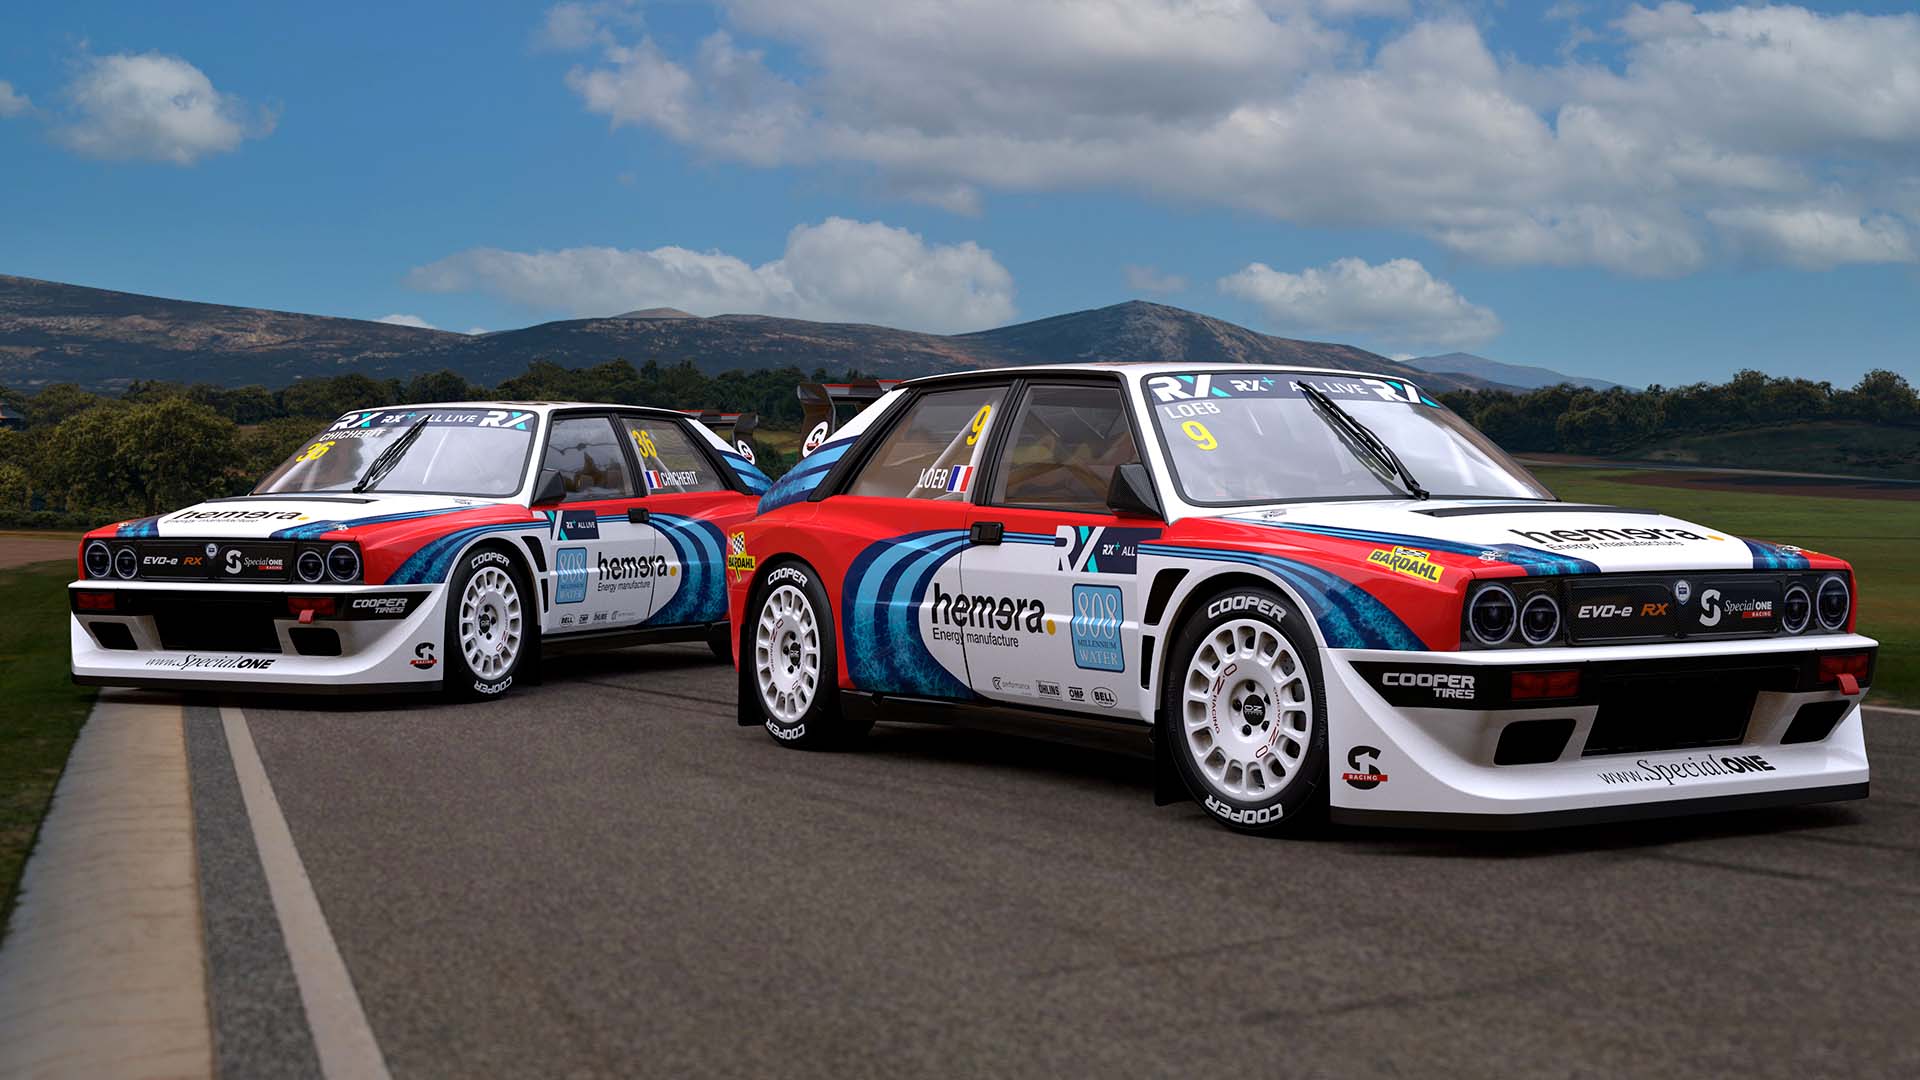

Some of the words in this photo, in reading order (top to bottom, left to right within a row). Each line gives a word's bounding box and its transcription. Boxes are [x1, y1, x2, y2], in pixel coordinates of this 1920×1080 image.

[1289, 381, 1327, 393] AL
[1323, 382, 1368, 395] LIVE
[444, 414, 476, 424] LIVE
[1165, 402, 1221, 420] LOEB
[967, 404, 992, 446] 9
[319, 428, 384, 442] CHICHERIT
[1181, 420, 1219, 451] 9
[296, 440, 336, 463] 36
[631, 429, 657, 459] 36
[660, 470, 698, 487] CHICHERIT
[917, 468, 949, 489] LOEB
[1121, 545, 1136, 556] ALL
[184, 556, 204, 565] RX
[471, 552, 510, 569] COOPER
[728, 557, 755, 569] BARDAHL
[1368, 549, 1440, 581] BARDAHL
[767, 567, 809, 588] COOPER
[353, 598, 408, 608] COOPER
[374, 606, 404, 614] TIRES
[1207, 595, 1287, 622] COOPER
[1640, 602, 1670, 617] RX
[1724, 598, 1755, 614] Special
[1755, 601, 1773, 611] ONE
[1077, 592, 1117, 639] 808
[932, 627, 963, 645] Energy
[966, 634, 1019, 648] manufacture
[1079, 651, 1117, 666] WATER
[474, 676, 512, 694] COOPER
[1382, 672, 1474, 689] COOPER
[1094, 691, 1114, 702] BELL
[1433, 687, 1474, 699] TIRES
[766, 718, 806, 740] COOPER
[1204, 794, 1284, 824] COOPER
